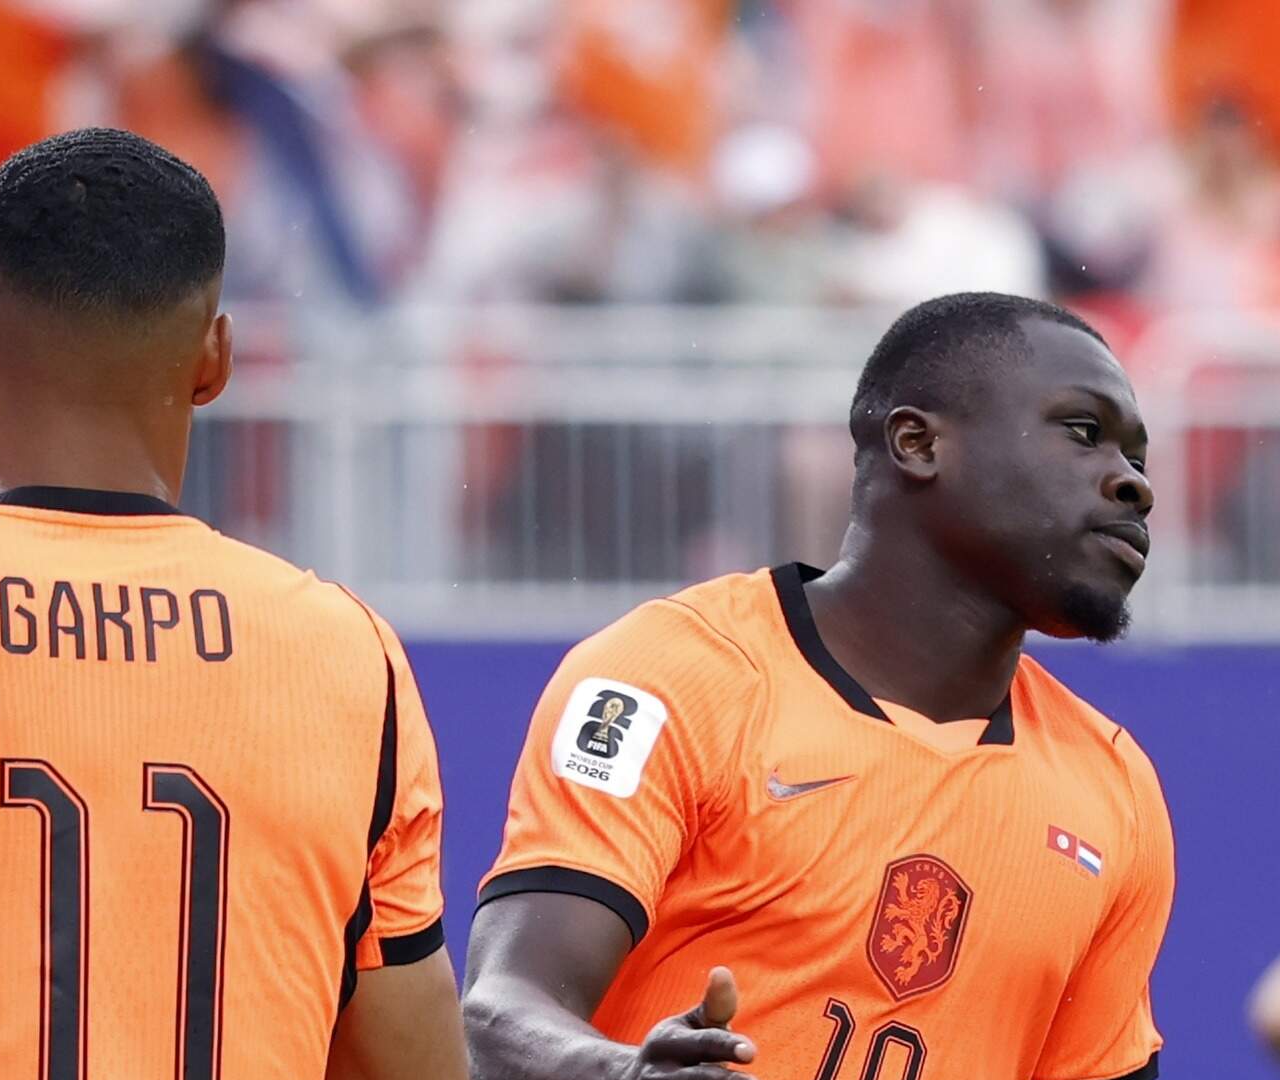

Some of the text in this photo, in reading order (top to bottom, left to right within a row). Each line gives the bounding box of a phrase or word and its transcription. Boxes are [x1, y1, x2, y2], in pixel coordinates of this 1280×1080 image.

[586, 739, 608, 753] FIFA
[570, 752, 614, 770] WORLD CUP
[565, 760, 611, 782] 2026
